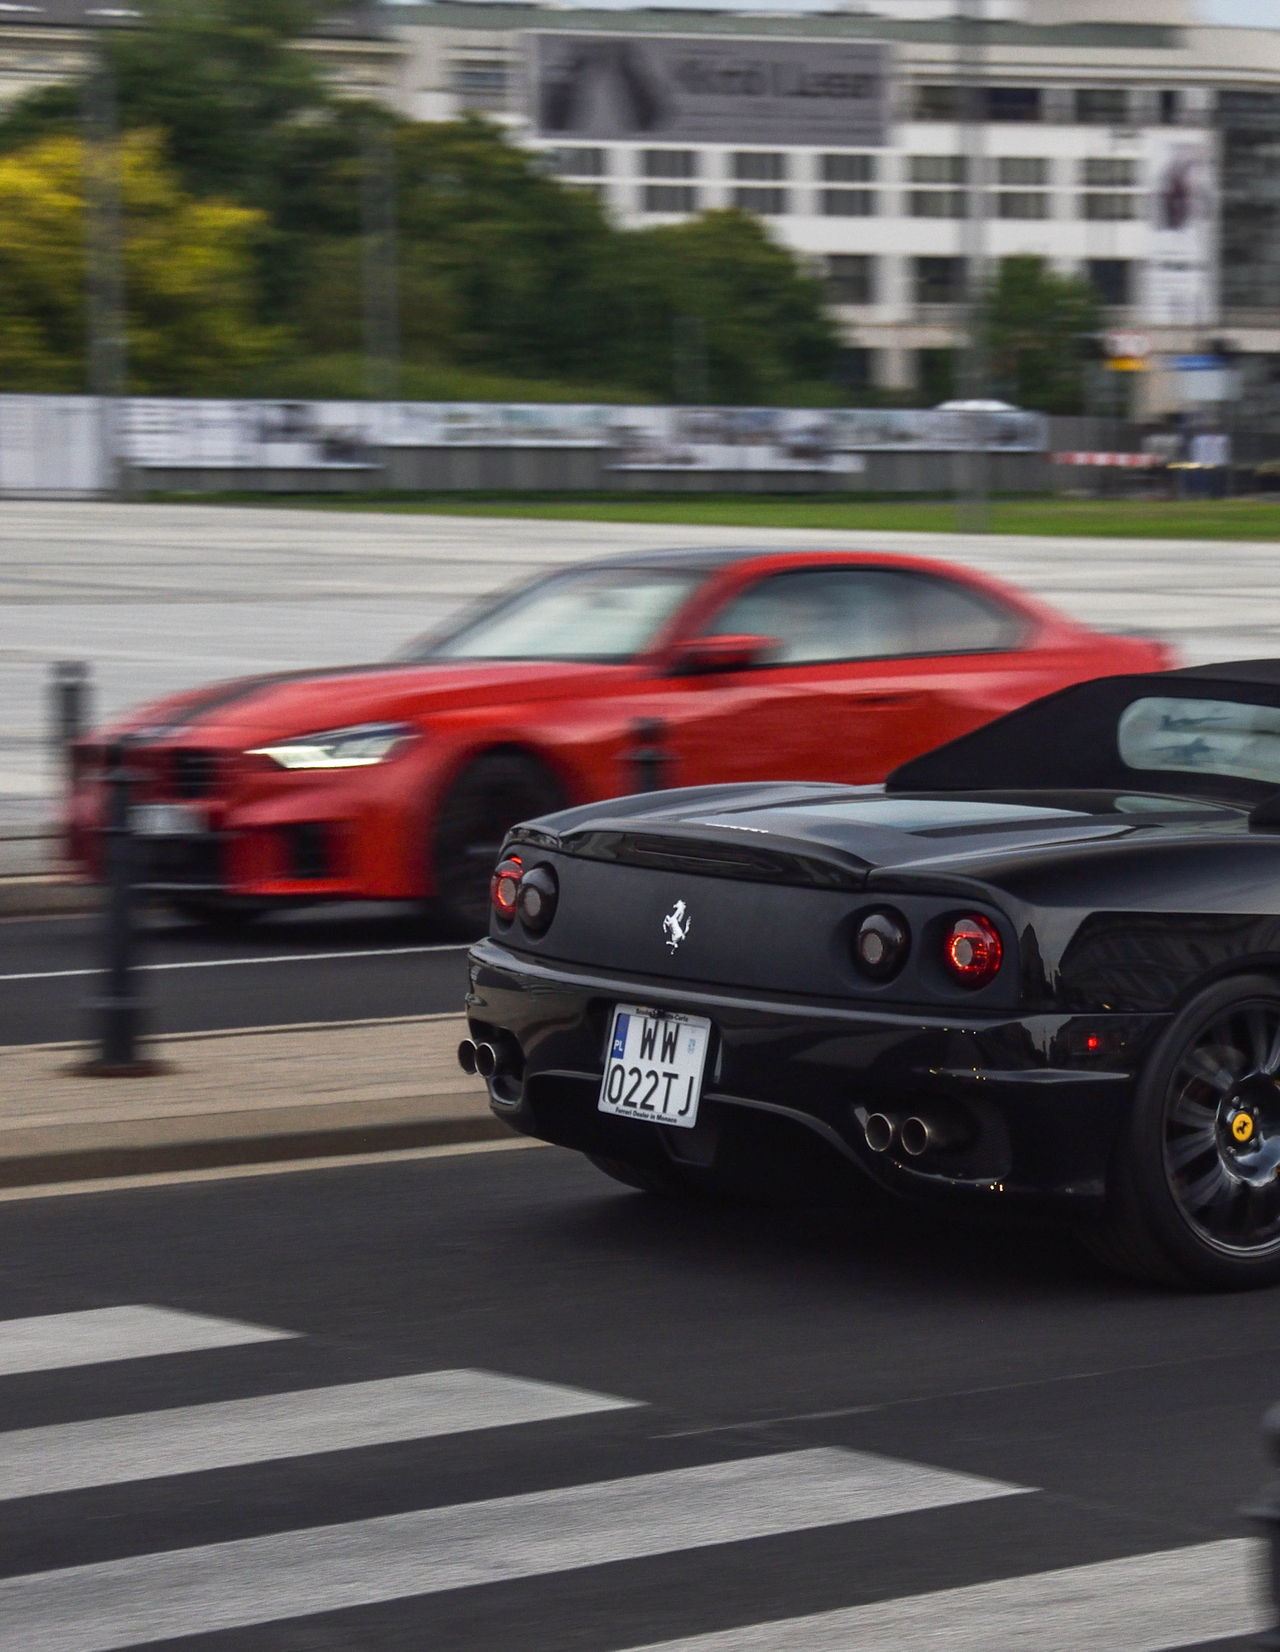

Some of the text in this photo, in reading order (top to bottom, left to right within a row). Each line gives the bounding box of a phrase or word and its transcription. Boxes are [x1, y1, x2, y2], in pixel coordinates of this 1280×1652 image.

[613, 1039, 623, 1051] PL
[640, 1017, 680, 1064] WW
[607, 1064, 694, 1116] 022TJ
[615, 1106, 632, 1115] Ferrari
[633, 1110, 649, 1119] Dealer
[657, 1114, 677, 1123] Monaco
